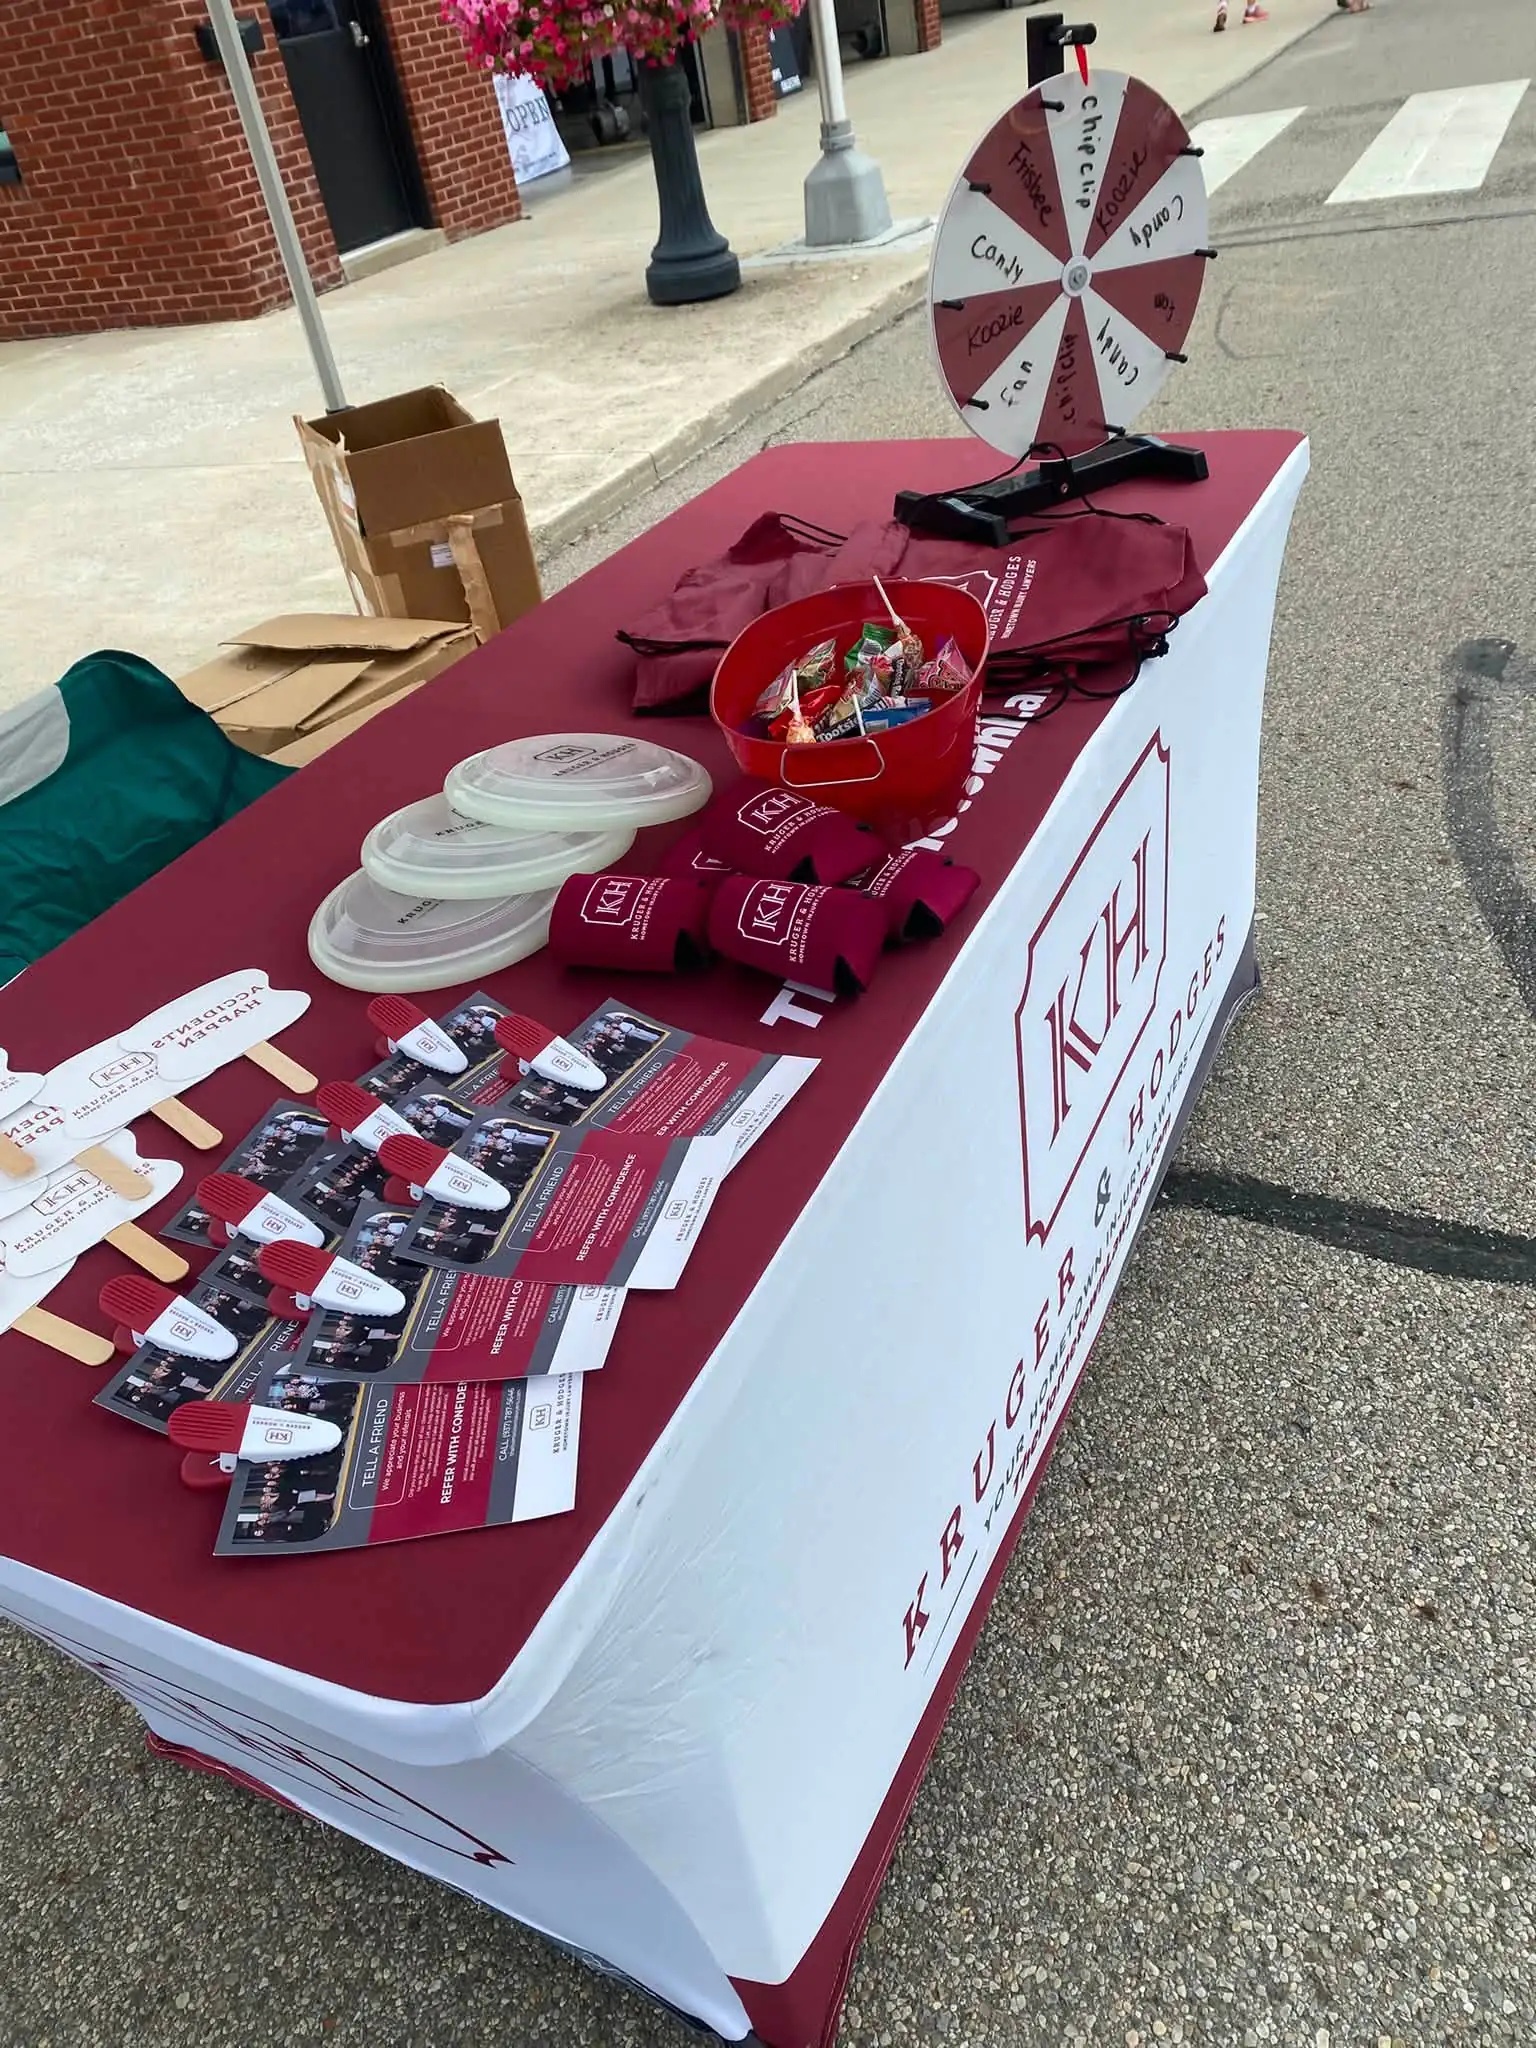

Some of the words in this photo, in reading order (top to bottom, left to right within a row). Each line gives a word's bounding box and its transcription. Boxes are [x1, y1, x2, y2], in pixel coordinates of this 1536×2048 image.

[506, 96, 549, 132] OPEN
[1008, 141, 1053, 227] Frisbee
[1131, 195, 1183, 248] Candy
[970, 234, 1024, 286] Candy
[967, 305, 1025, 356] Koozie
[1096, 316, 1139, 386] Candy
[751, 793, 802, 824] KH
[764, 821, 795, 851] KRUGER
[595, 881, 632, 916] KH
[872, 878, 886, 896] UGER
[397, 900, 432, 924] KRUG
[630, 904, 646, 940] KRUGER
[752, 883, 794, 933] KH
[789, 918, 803, 962] KRUGER
[1044, 827, 1151, 1148] KH
[100, 1057, 142, 1081] KH
[72, 1083, 126, 1116] KRUGER
[607, 1096, 630, 1113] TELL
[628, 1089, 635, 1097] A
[634, 1062, 662, 1090] FRIEND
[668, 1103, 689, 1125] WITH
[687, 1060, 729, 1107] CONFIDENCE
[44, 1176, 89, 1207] KH
[521, 1208, 541, 1232] TELL
[540, 1167, 564, 1202] FRIEND
[576, 1233, 596, 1260] REFER
[593, 1208, 609, 1233] WITH
[605, 1153, 637, 1207] CONFIDENCE
[14, 1210, 73, 1250] KRUGER
[633, 1221, 643, 1238] CALL
[440, 1270, 457, 1296] FRIE
[902, 1246, 1076, 1671] KRUGER
[1094, 1166, 1111, 1228] &
[1128, 914, 1226, 1153] HODGES
[984, 1434, 1025, 1532] YOUR
[1029, 1247, 1102, 1429] HOMETOWN
[1106, 1152, 1142, 1246] INJURY
[1146, 1054, 1188, 1153] LAWYERS
[426, 1305, 444, 1332] TELL
[441, 1298, 449, 1306] A
[548, 1302, 559, 1323] CALL
[491, 1323, 508, 1355] REFER
[503, 1294, 518, 1322] WITH
[234, 1369, 263, 1395] TELL
[269, 1320, 299, 1352] RIEND
[369, 1398, 388, 1443] FRIEND
[393, 1391, 405, 1420] business
[400, 1408, 411, 1436] referrals
[451, 1380, 467, 1433] CONFIDE
[535, 1408, 545, 1426] KH
[392, 1422, 401, 1438] your
[398, 1437, 408, 1454] your
[552, 1418, 561, 1453] KRUGER
[367, 1445, 380, 1455] A
[383, 1439, 398, 1477] appreciate
[394, 1454, 404, 1469] and
[446, 1435, 459, 1465] WITH
[498, 1438, 508, 1461] CALL
[361, 1456, 378, 1487] TELL
[381, 1478, 390, 1490] We
[440, 1466, 455, 1503] REFER
